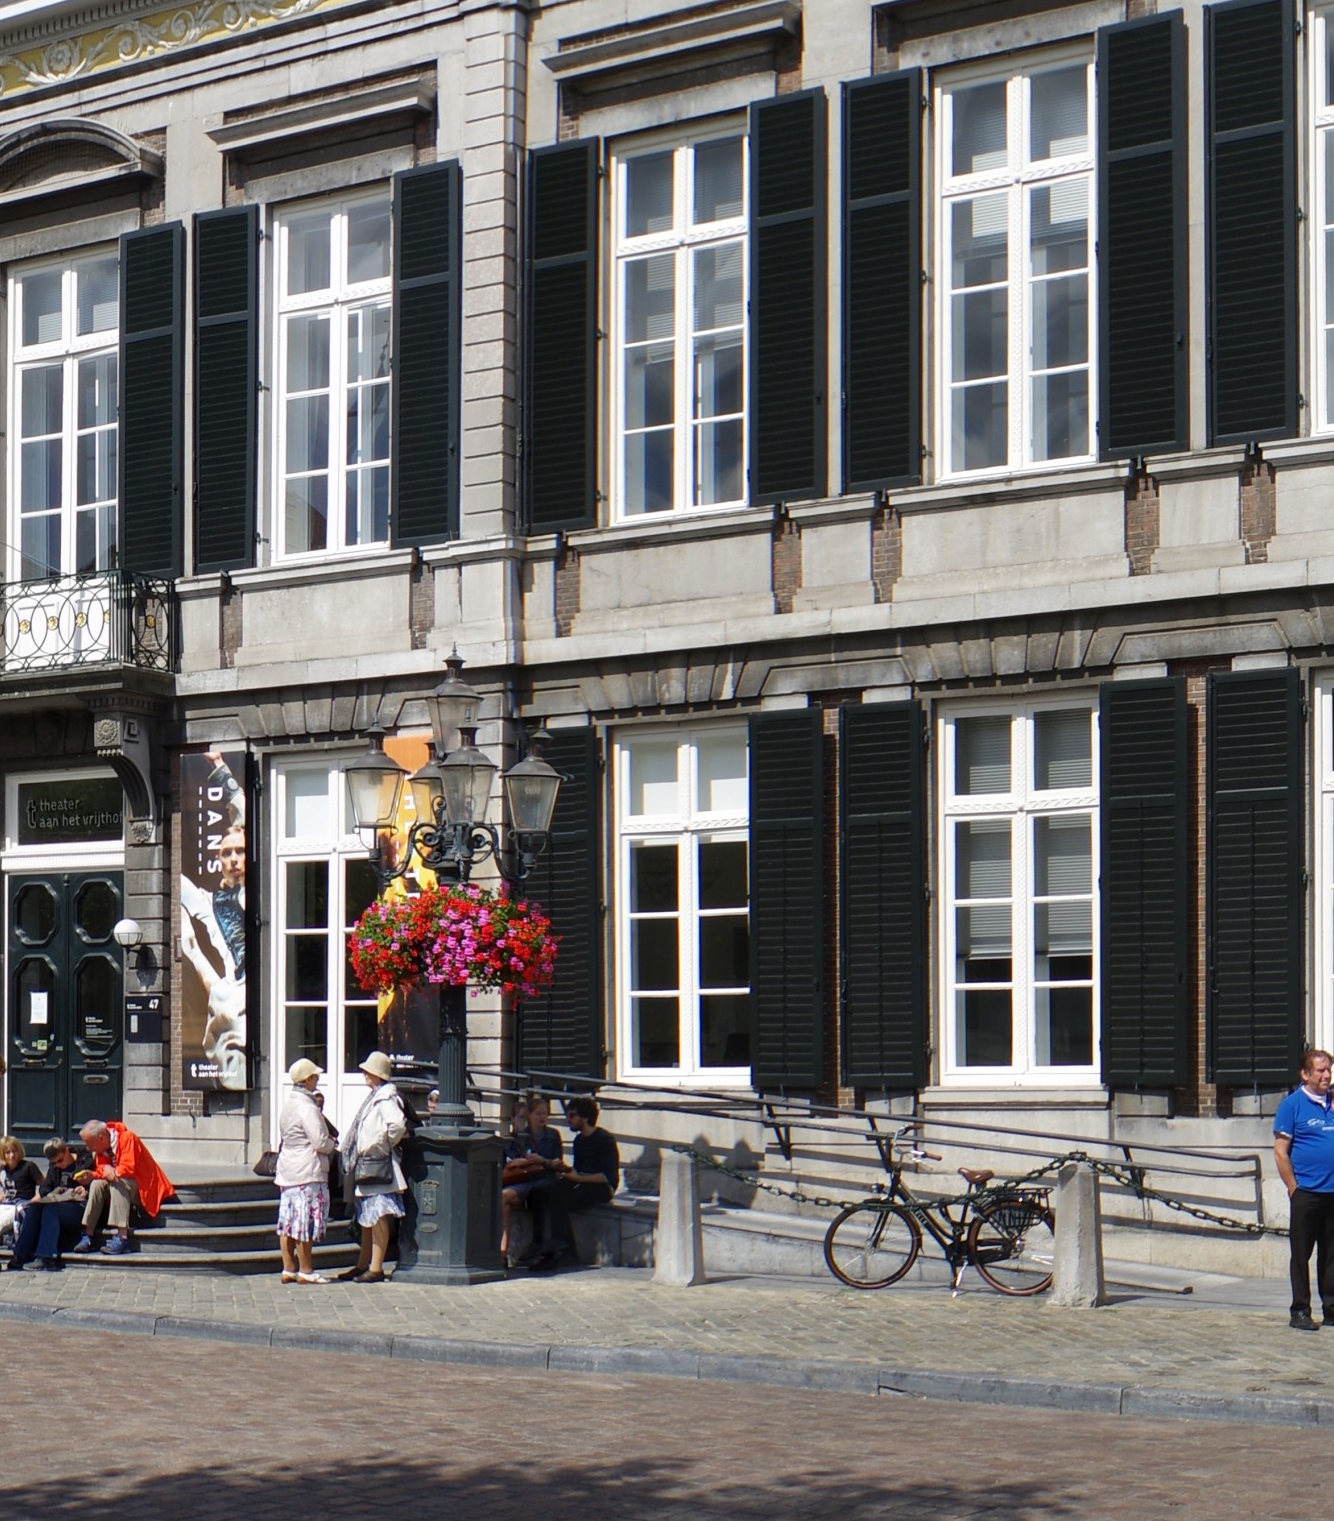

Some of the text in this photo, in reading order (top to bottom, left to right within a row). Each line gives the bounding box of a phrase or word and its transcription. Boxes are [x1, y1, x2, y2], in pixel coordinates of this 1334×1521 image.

[40, 798, 82, 812] theater
[39, 810, 123, 829] aan het vrijthof
[207, 786, 223, 873] DANS
[149, 999, 159, 1009] 47
